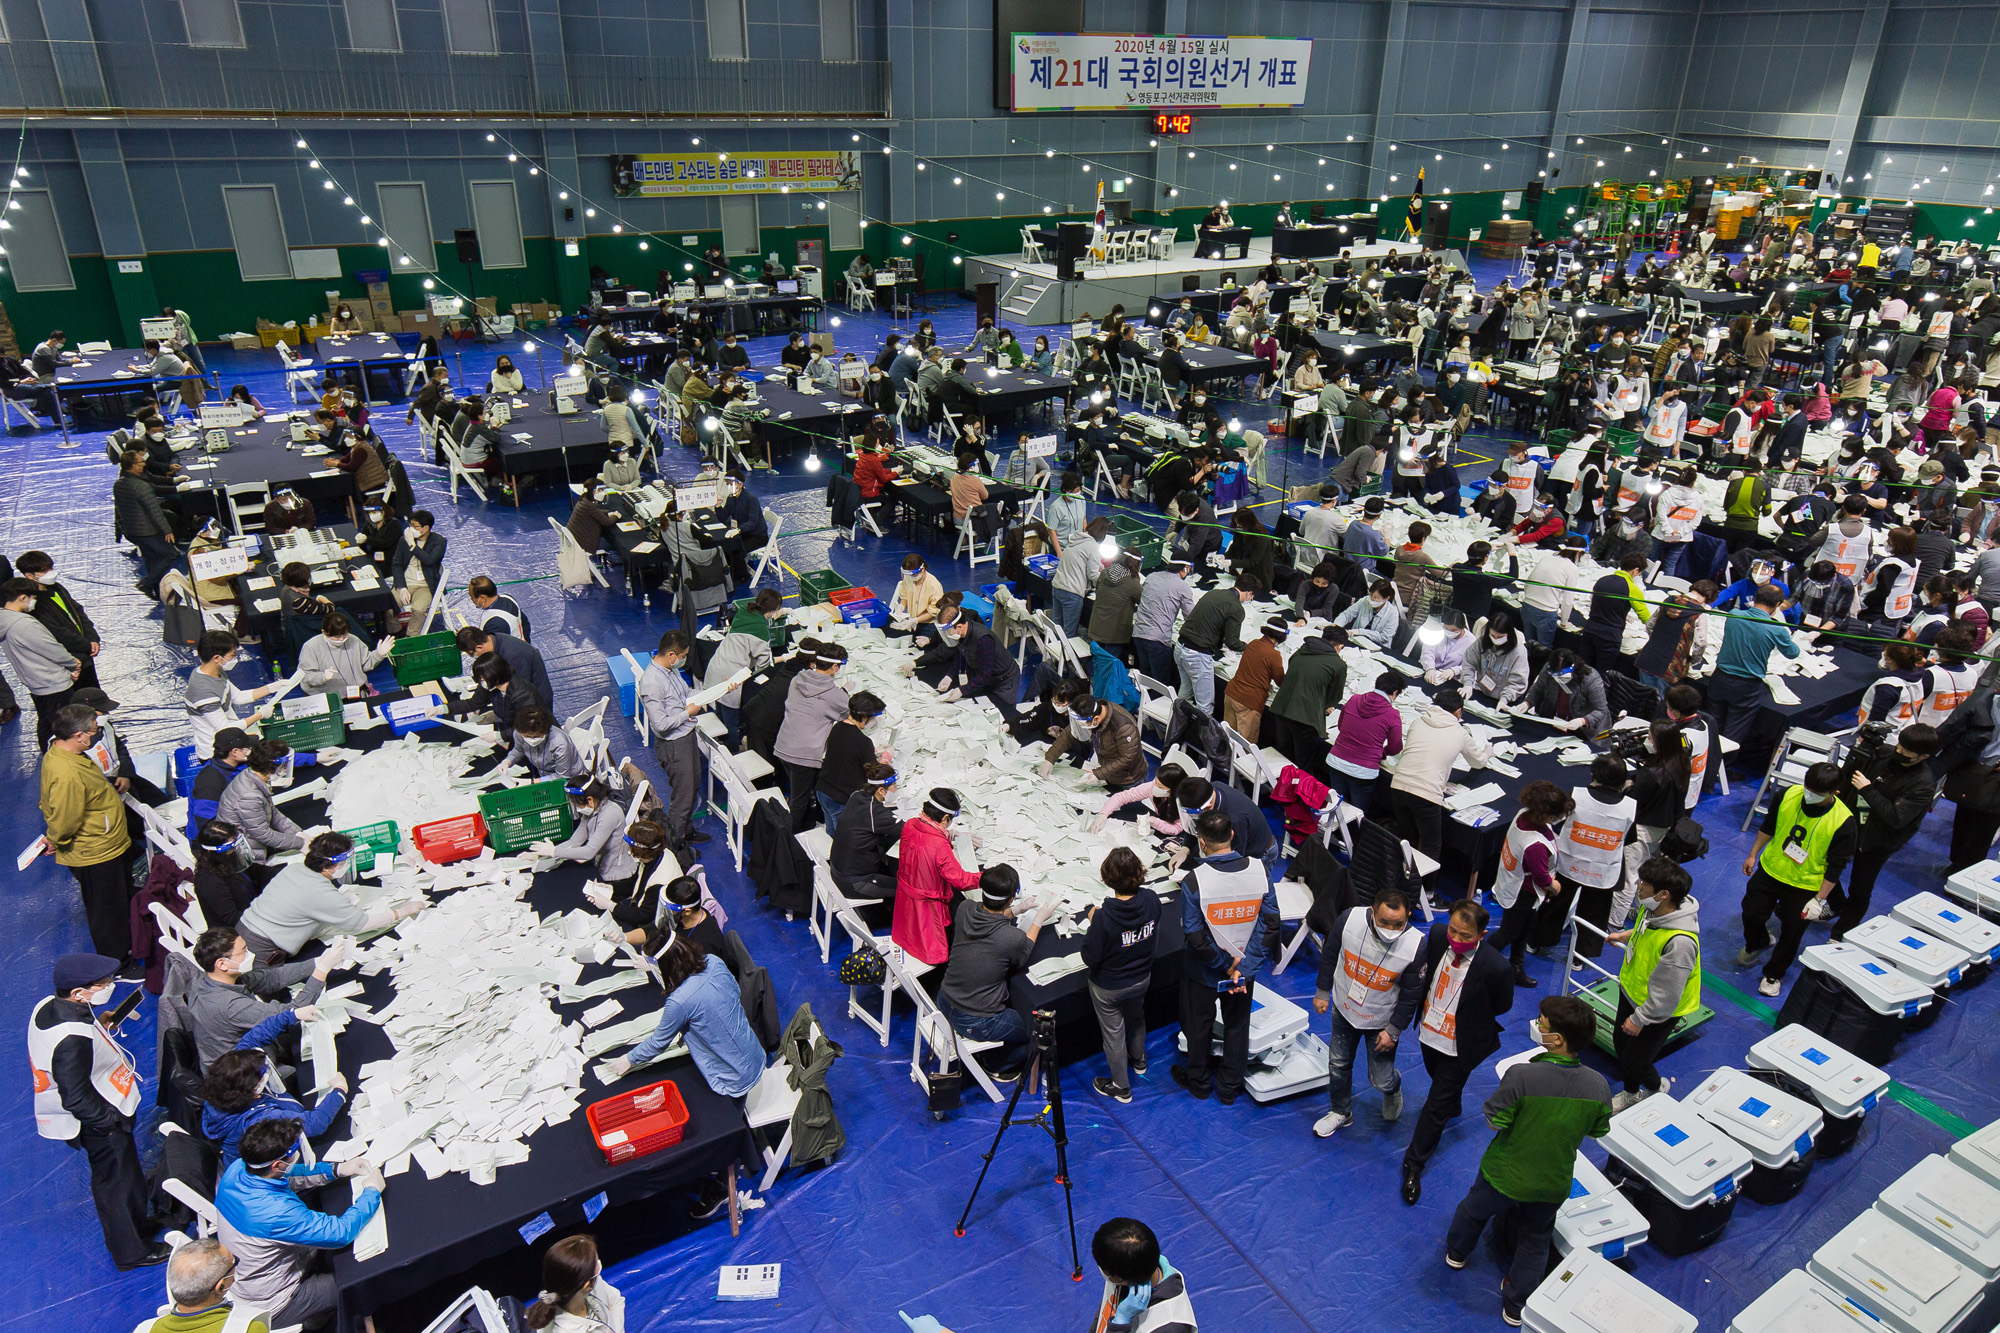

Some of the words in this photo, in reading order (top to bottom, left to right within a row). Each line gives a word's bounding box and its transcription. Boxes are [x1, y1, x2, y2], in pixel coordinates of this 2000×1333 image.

[1114, 39, 1155, 54] 2020년
[1158, 39, 1177, 54] 4월
[1180, 40, 1205, 55] 15일
[1208, 40, 1230, 55] 실시
[1029, 56, 1109, 89] 제21대
[1118, 56, 1251, 89] 국회의원선거
[1257, 58, 1298, 89] 개표
[1138, 91, 1218, 104] 영등포구선거관리위원회
[632, 160, 675, 182] 배드민턴
[677, 159, 716, 181] 고수되는
[718, 159, 738, 180] 숨은
[768, 158, 806, 178] 배드민턴
[807, 157, 843, 178] 필라테스
[1576, 827, 1618, 846] 개표참관
[1212, 905, 1256, 920] 개표참관
[1347, 958, 1391, 987] 개표참관
